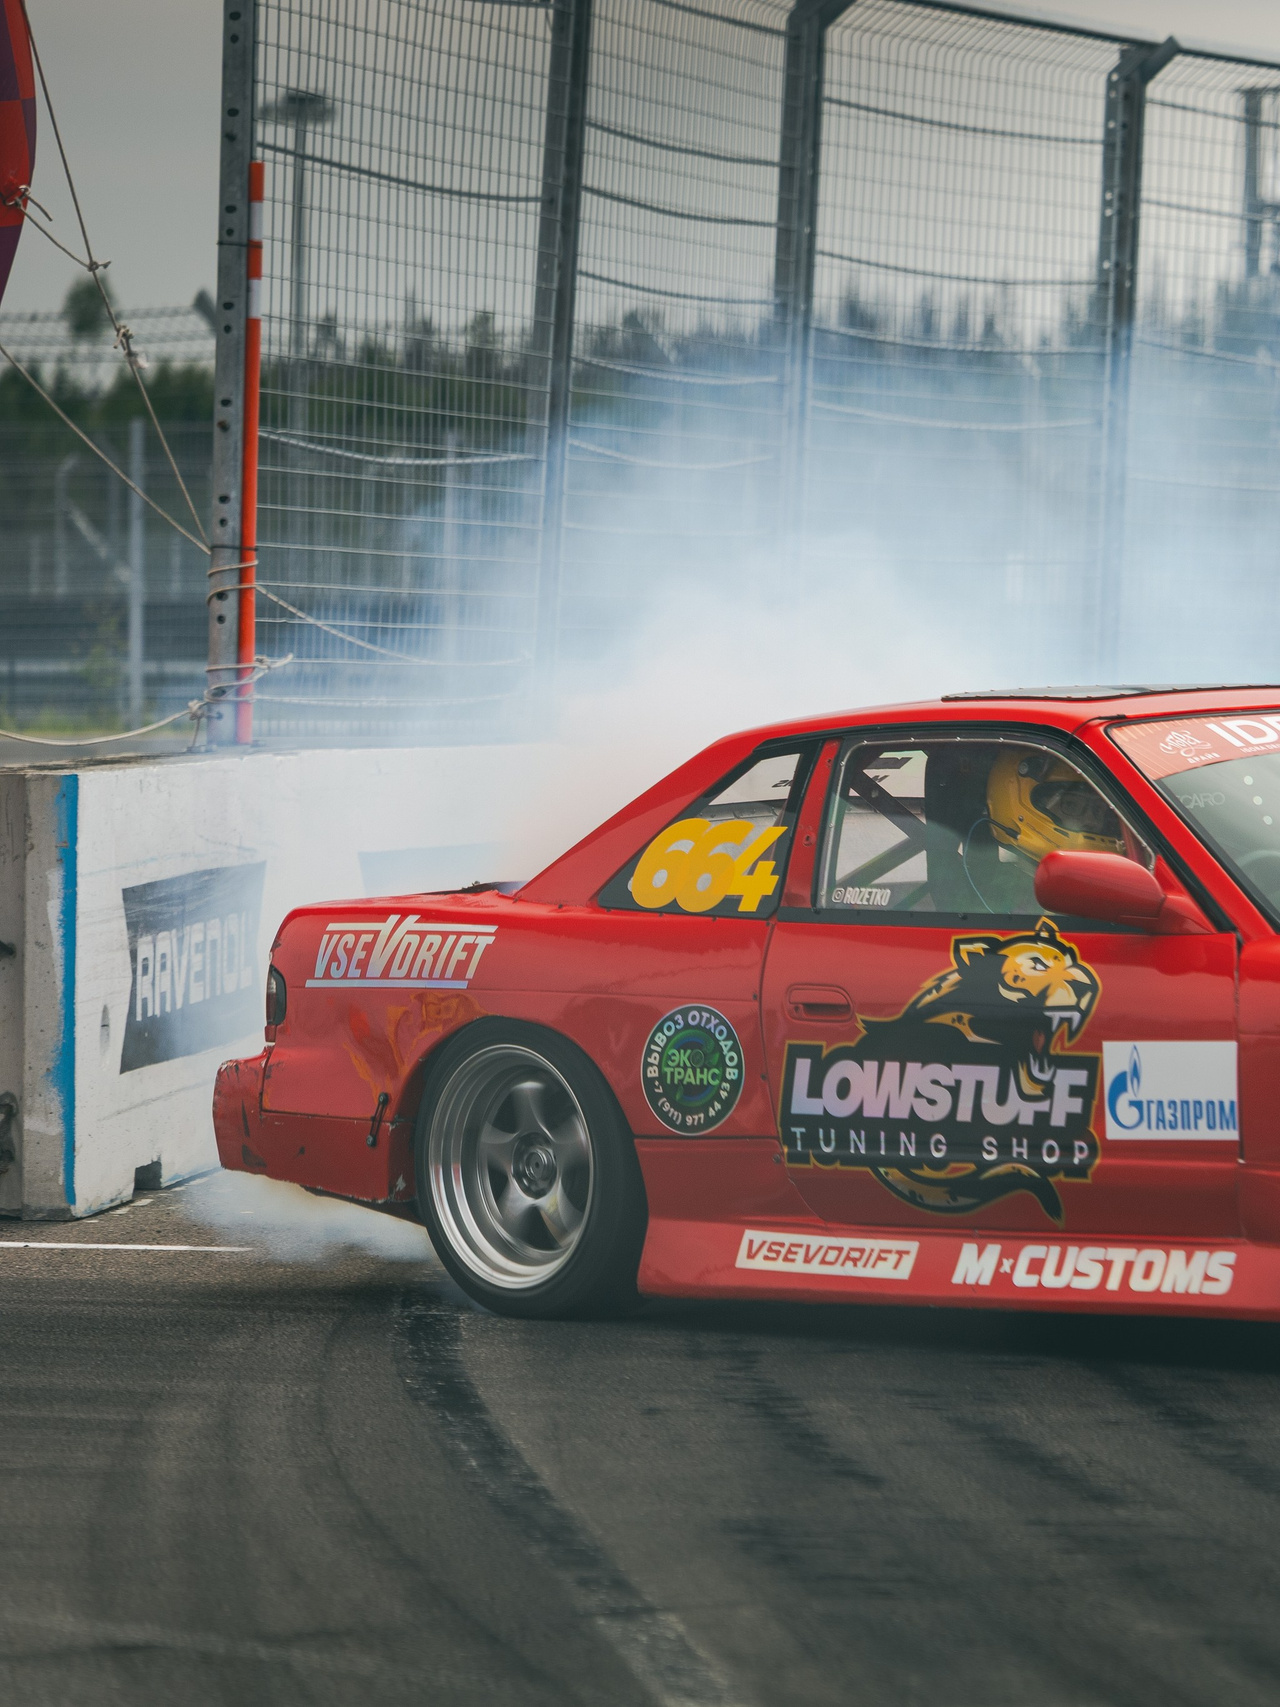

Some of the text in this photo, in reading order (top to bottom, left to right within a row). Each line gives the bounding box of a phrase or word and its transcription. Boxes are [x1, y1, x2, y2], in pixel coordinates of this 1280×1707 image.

[631, 817, 789, 913] 664
[843, 886, 892, 906] ROZETKO
[135, 910, 254, 1022] RAVENOL
[646, 1010, 739, 1080] ВЫВОЗ ОТХОДОВ
[663, 1067, 721, 1086] ТРАНС
[657, 1097, 683, 1126] (911)
[685, 1113, 705, 1126] 977
[708, 1100, 722, 1117] 44
[719, 1081, 731, 1100] 43
[1145, 1099, 1238, 1132] ГАЗПРОМ
[790, 1127, 1090, 1164] TUNING SHOP
[744, 1238, 911, 1271] VSEVDRIFT
